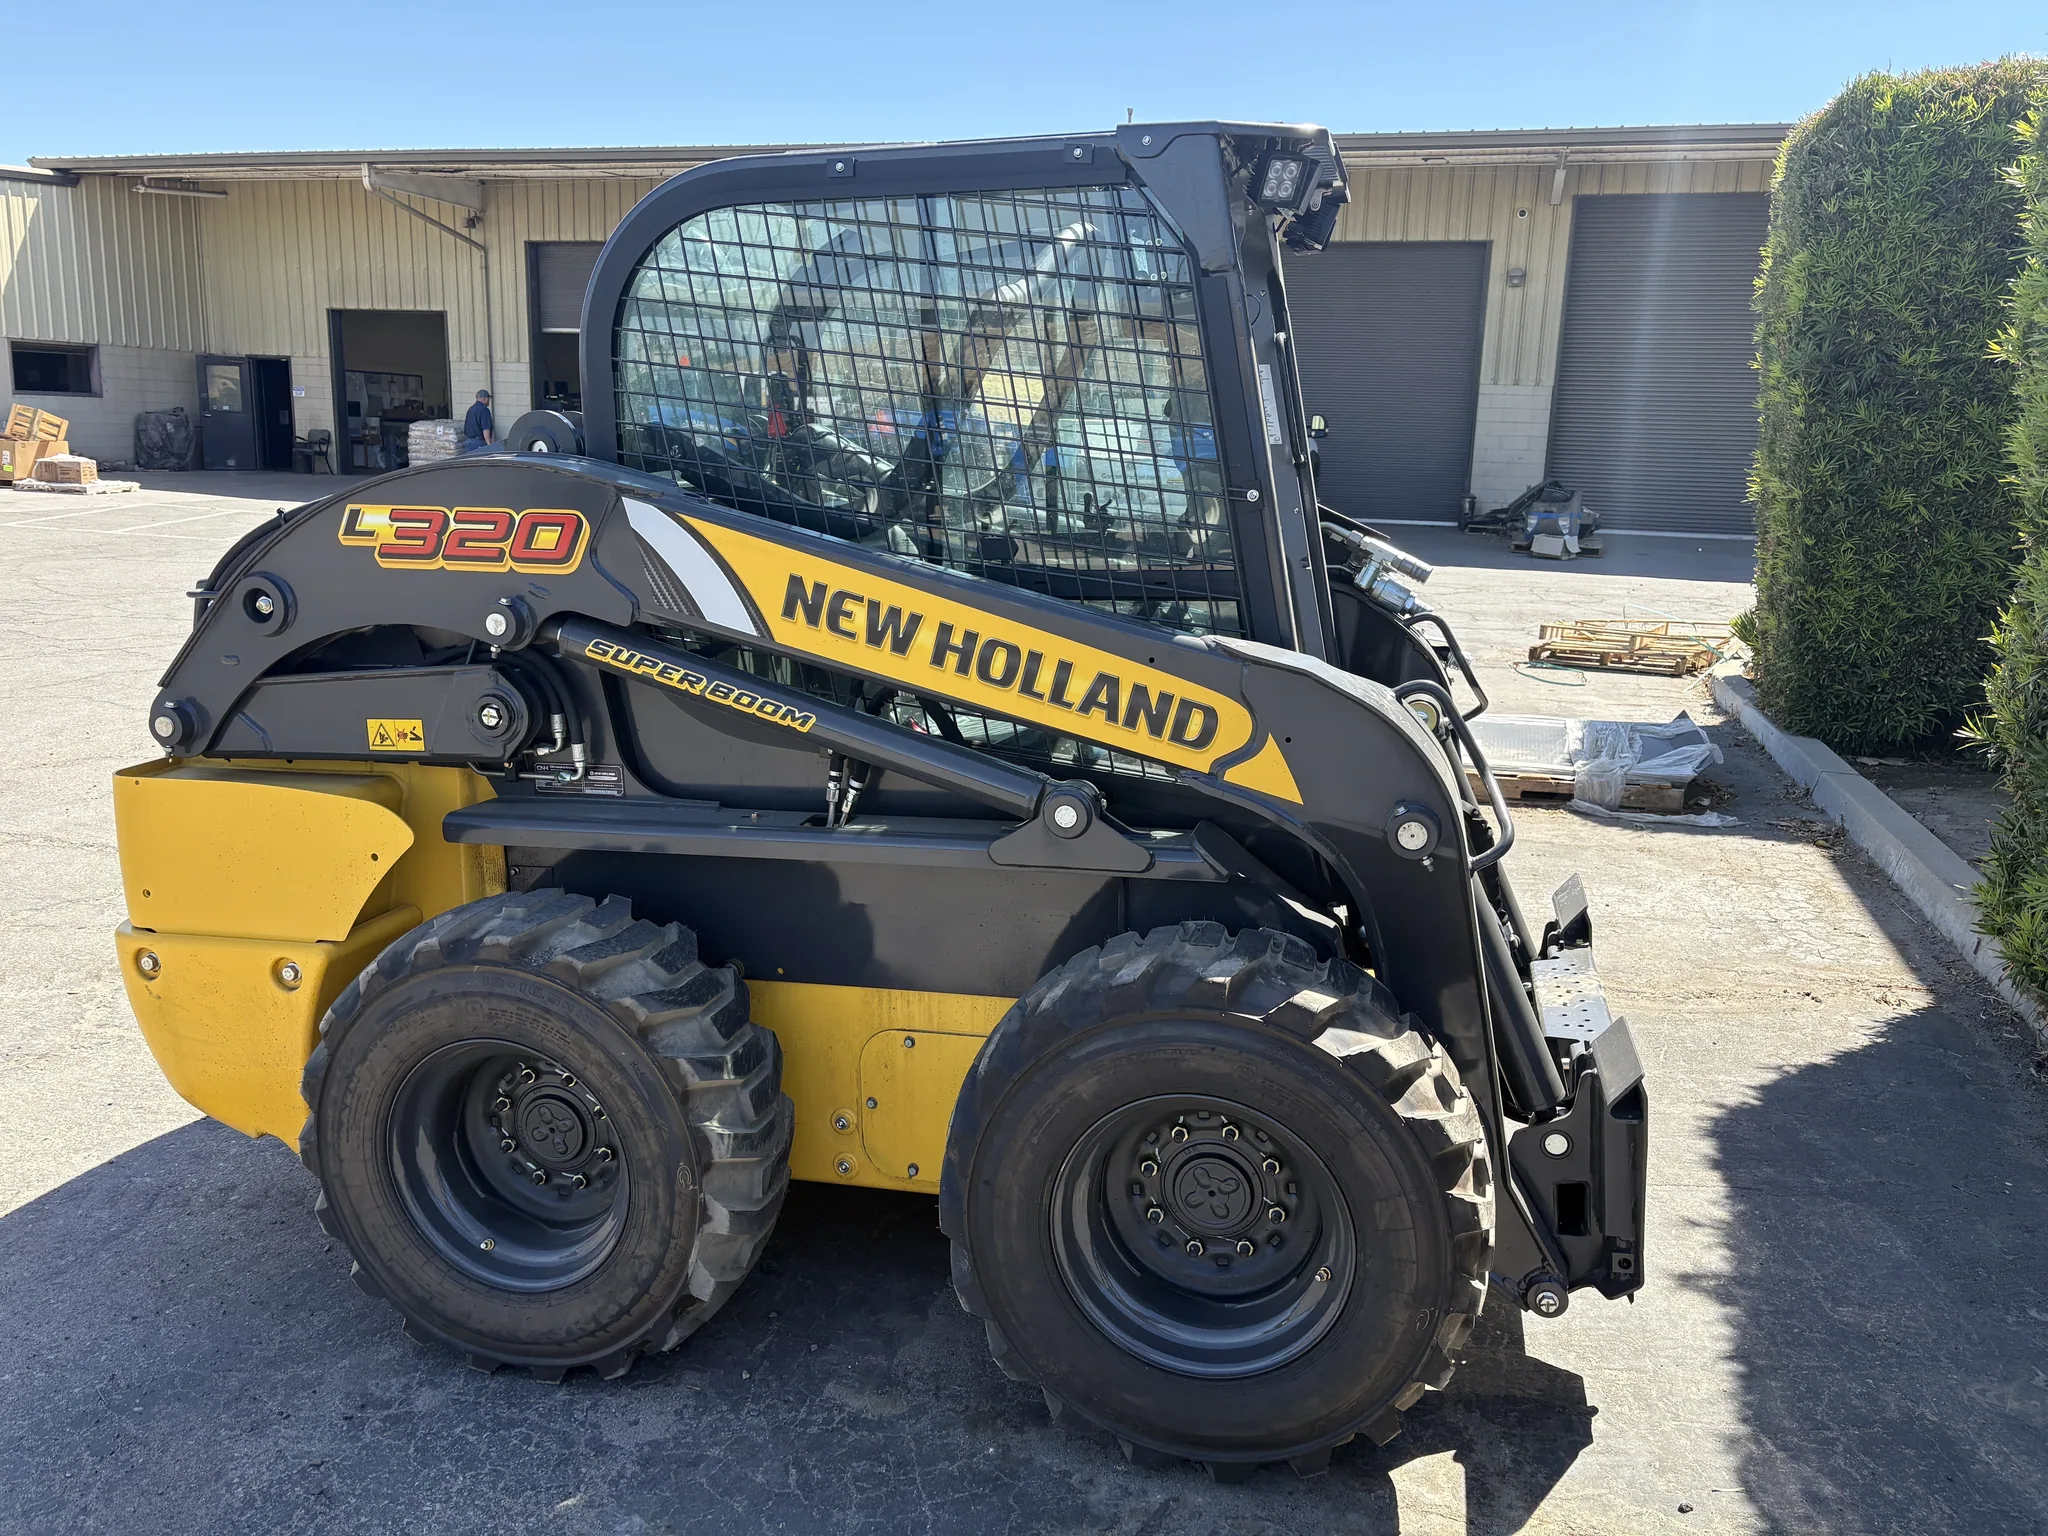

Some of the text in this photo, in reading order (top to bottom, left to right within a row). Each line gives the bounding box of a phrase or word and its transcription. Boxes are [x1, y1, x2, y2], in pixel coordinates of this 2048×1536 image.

[338, 504, 590, 574] L320
[585, 638, 816, 733] SUPER BOOM
[780, 573, 1219, 751] NEW HOLLAND
